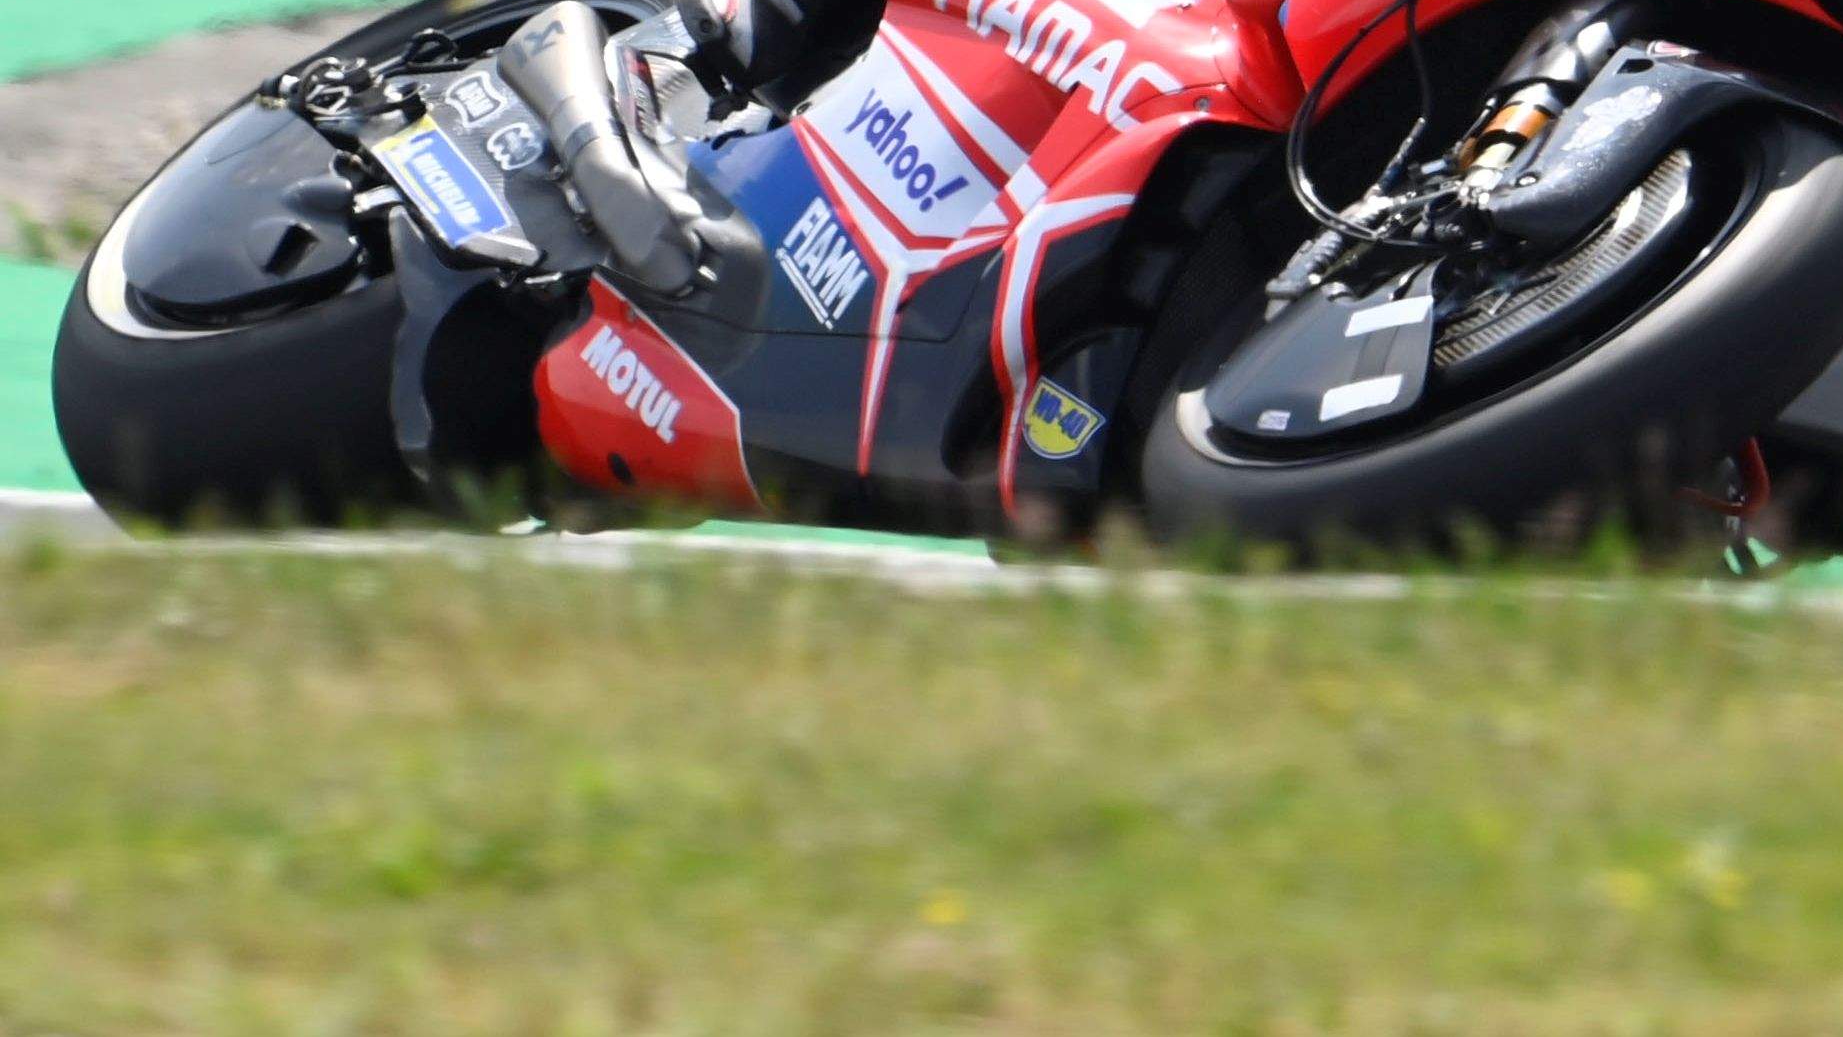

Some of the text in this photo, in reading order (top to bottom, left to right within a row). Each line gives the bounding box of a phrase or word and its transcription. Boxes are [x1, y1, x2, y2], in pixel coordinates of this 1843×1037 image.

[411, 150, 482, 228] MICHELIN
[843, 88, 969, 212] yahoo!
[783, 196, 868, 321] FIAMM
[582, 324, 682, 444] MOTUL
[1033, 387, 1090, 440] WD-40
